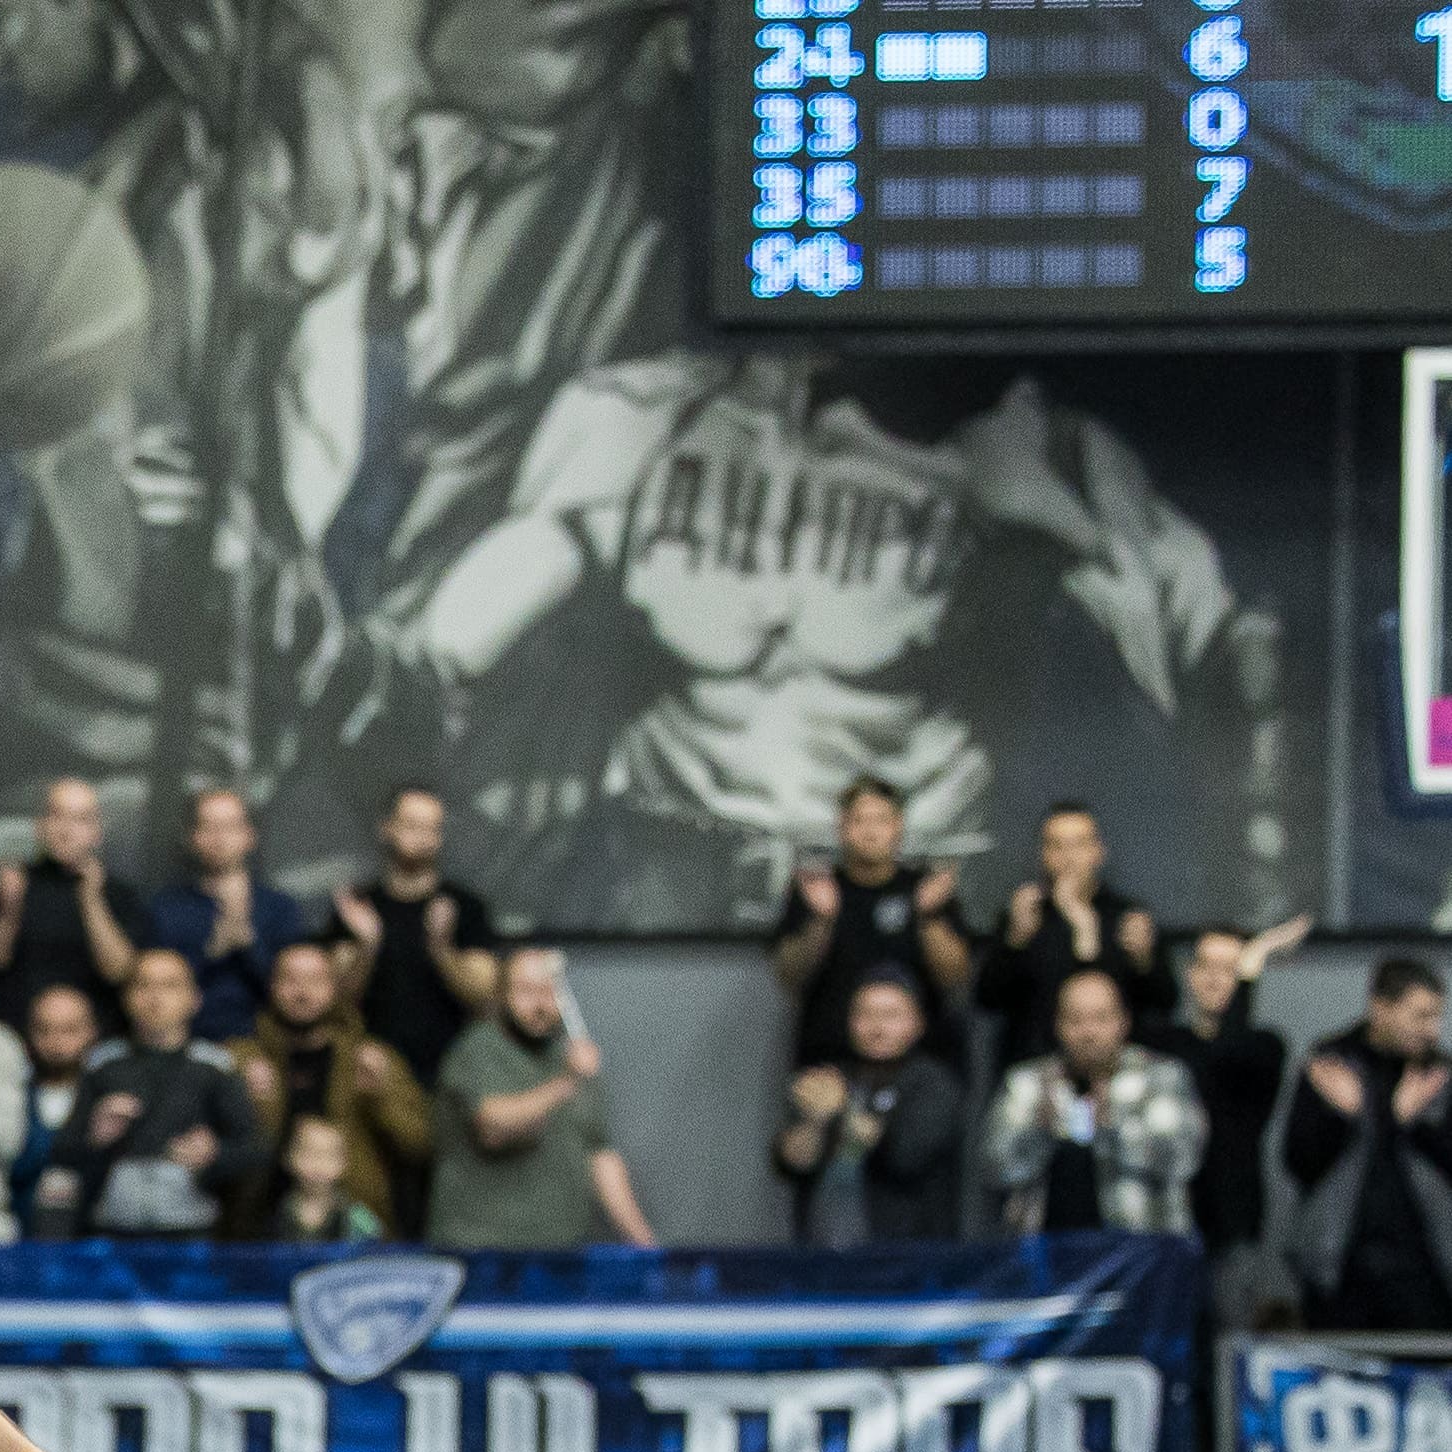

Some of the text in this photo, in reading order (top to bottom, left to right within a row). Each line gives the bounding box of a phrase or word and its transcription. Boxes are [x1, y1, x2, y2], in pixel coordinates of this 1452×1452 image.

[753, 15, 1248, 88] 24 6
[752, 87, 1249, 158] 33 0
[752, 156, 1251, 229] 35 7
[1193, 226, 1248, 292] 5
